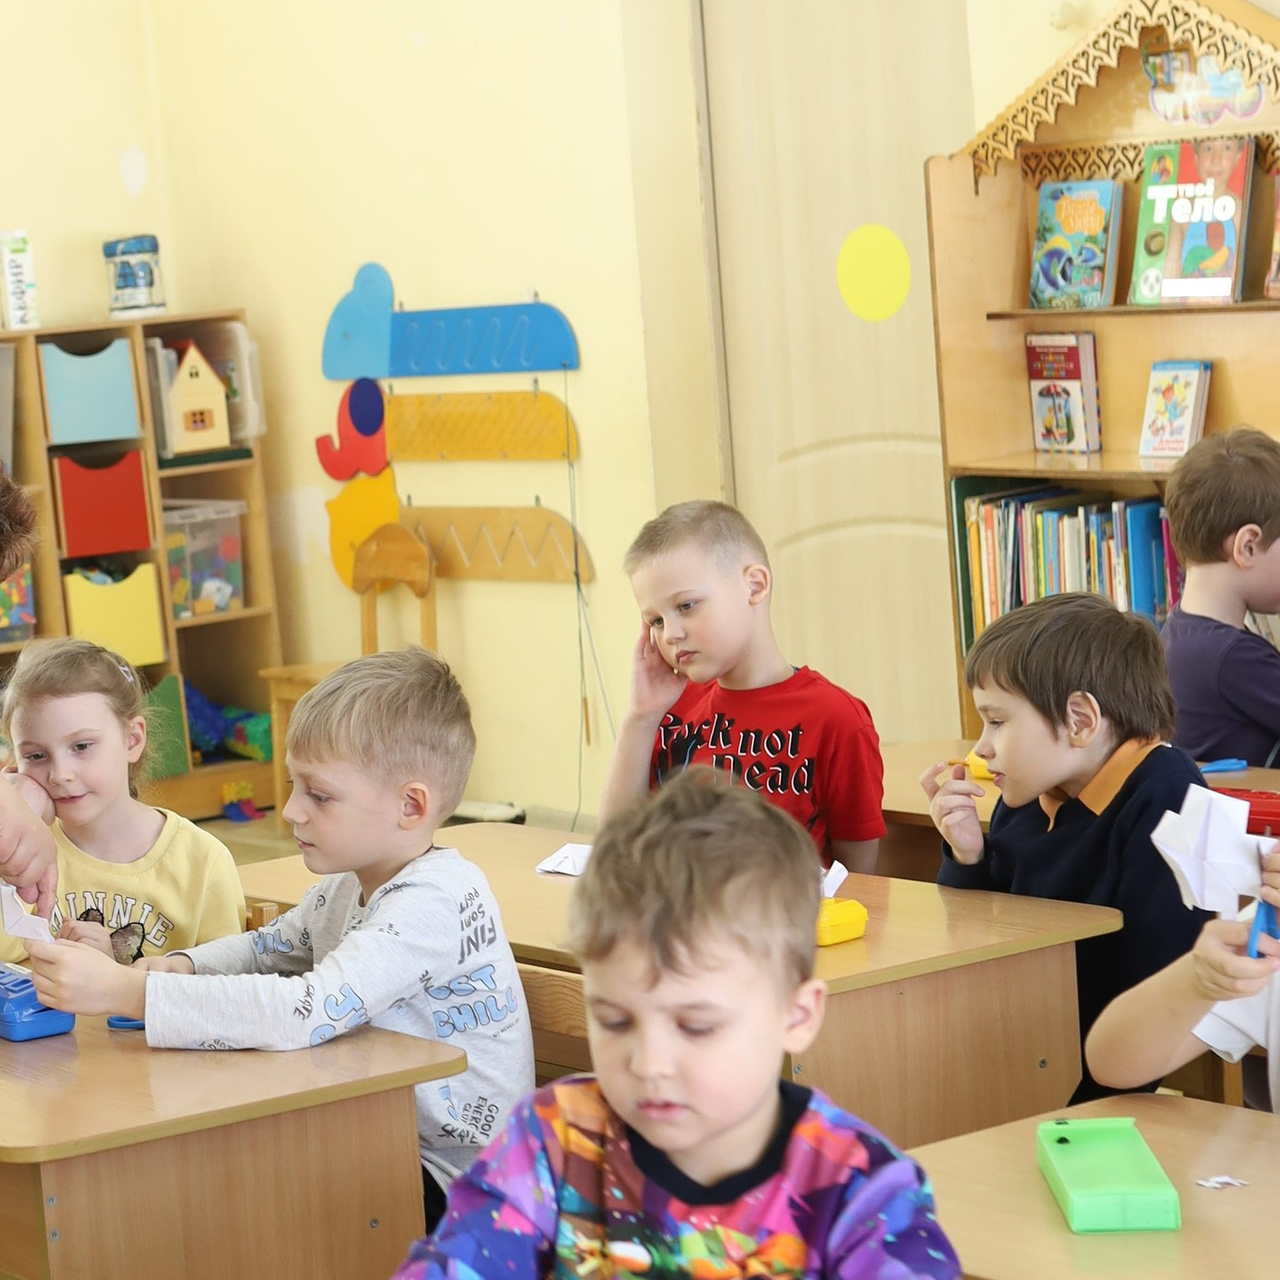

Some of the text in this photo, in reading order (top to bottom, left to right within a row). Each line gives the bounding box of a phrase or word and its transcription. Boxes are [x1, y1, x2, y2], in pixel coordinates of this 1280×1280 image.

[1147, 184, 1236, 224] Тело
[8, 258, 27, 325] КЕФИР
[738, 723, 804, 759] not
